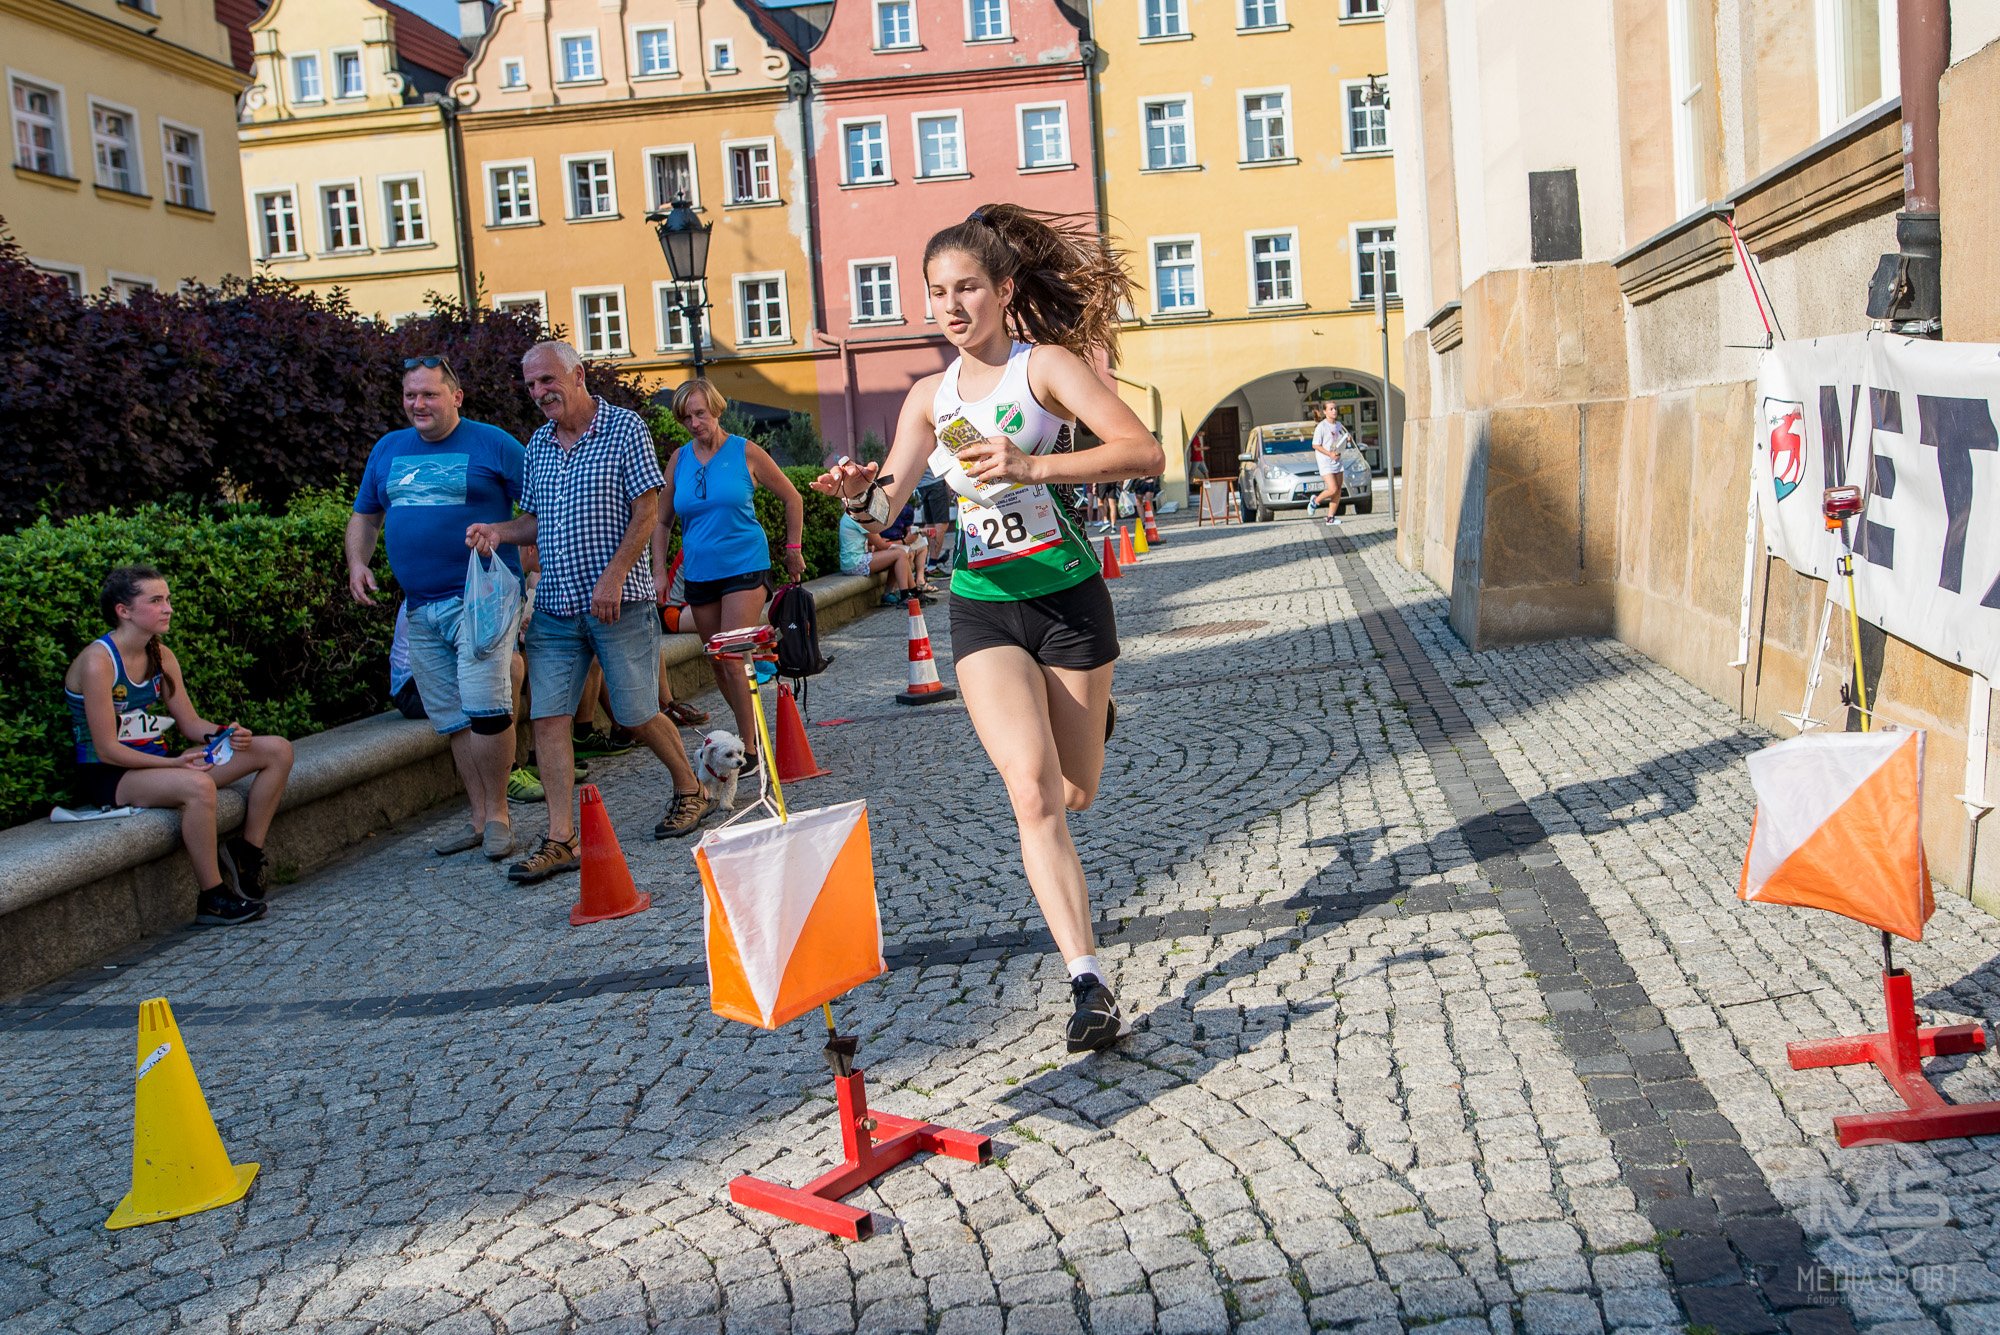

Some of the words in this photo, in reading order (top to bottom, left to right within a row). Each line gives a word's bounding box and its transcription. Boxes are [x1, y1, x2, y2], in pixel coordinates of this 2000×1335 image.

[1819, 384, 2000, 609] MET
[982, 511, 1027, 549] 28
[138, 714, 159, 733] 12
